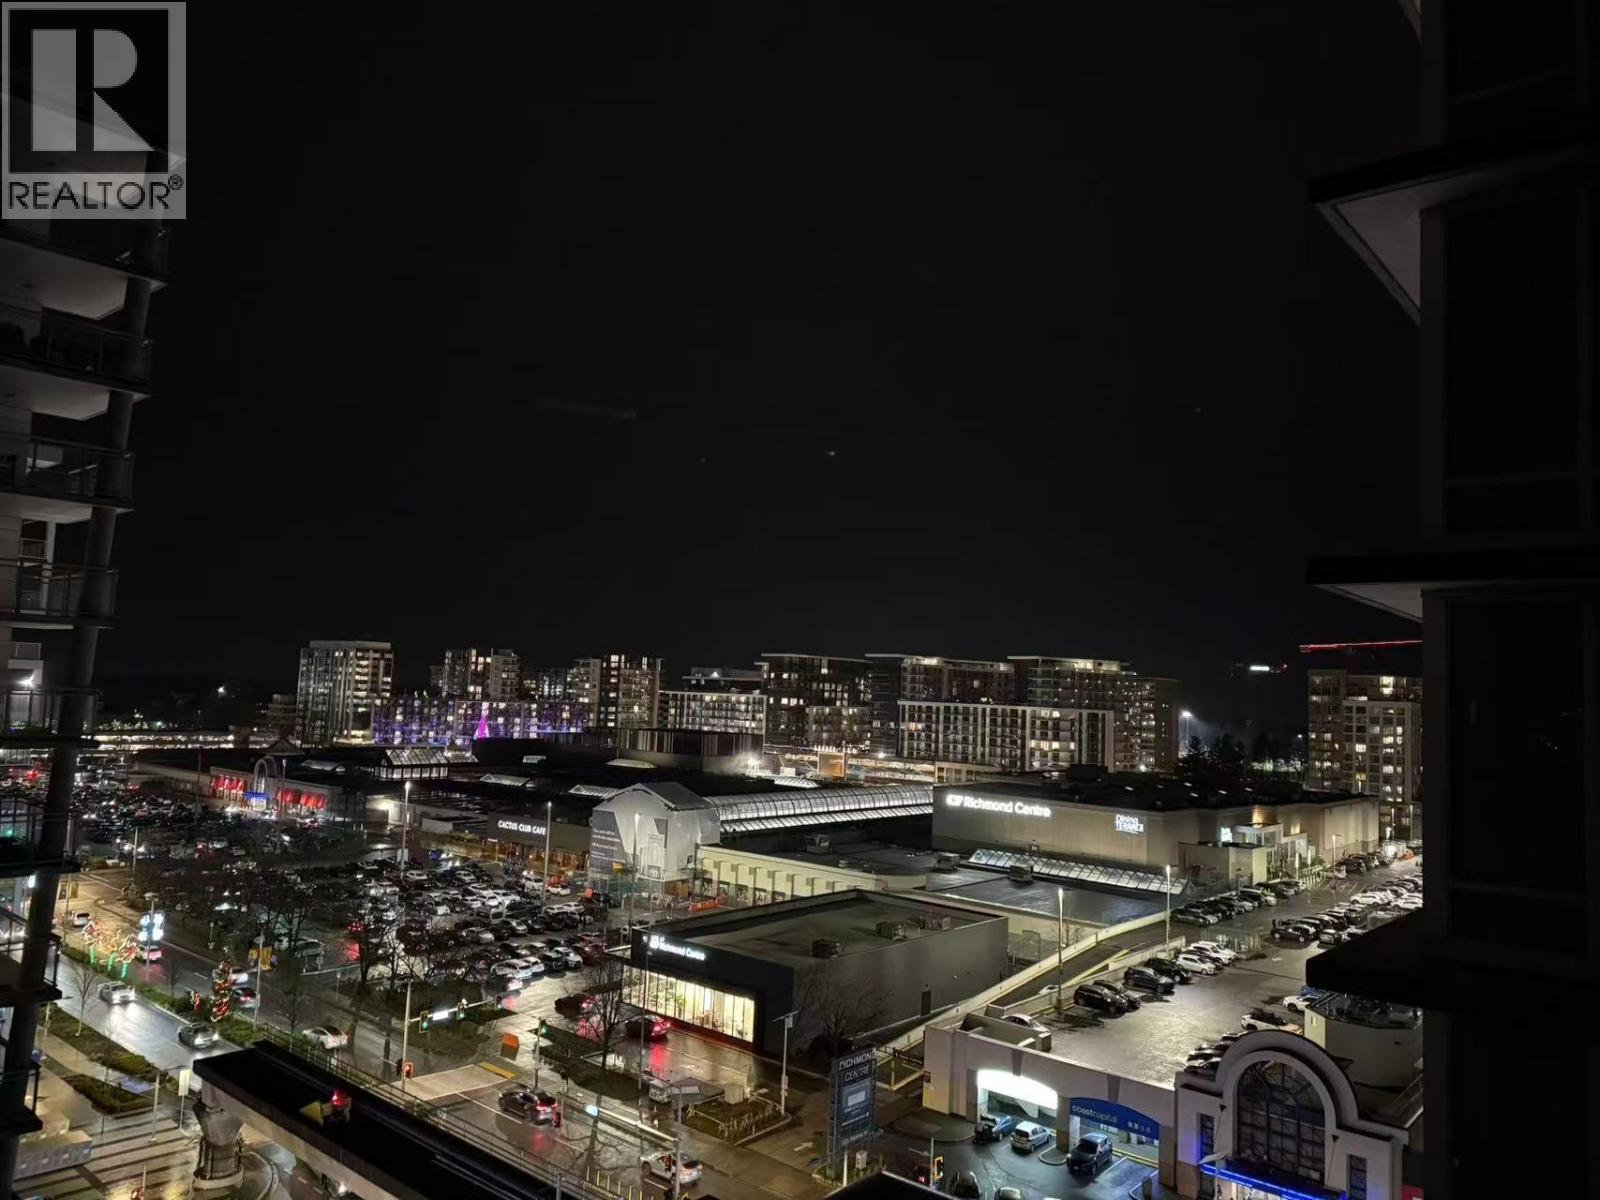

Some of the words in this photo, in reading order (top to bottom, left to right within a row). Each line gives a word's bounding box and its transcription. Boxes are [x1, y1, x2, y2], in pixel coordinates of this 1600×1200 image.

[963, 796, 1014, 813] Richmond
[1014, 801, 1052, 817] Centre
[497, 820, 518, 831] CACTUS
[518, 823, 532, 833] CLUB
[845, 1065, 870, 1082] CENTRE
